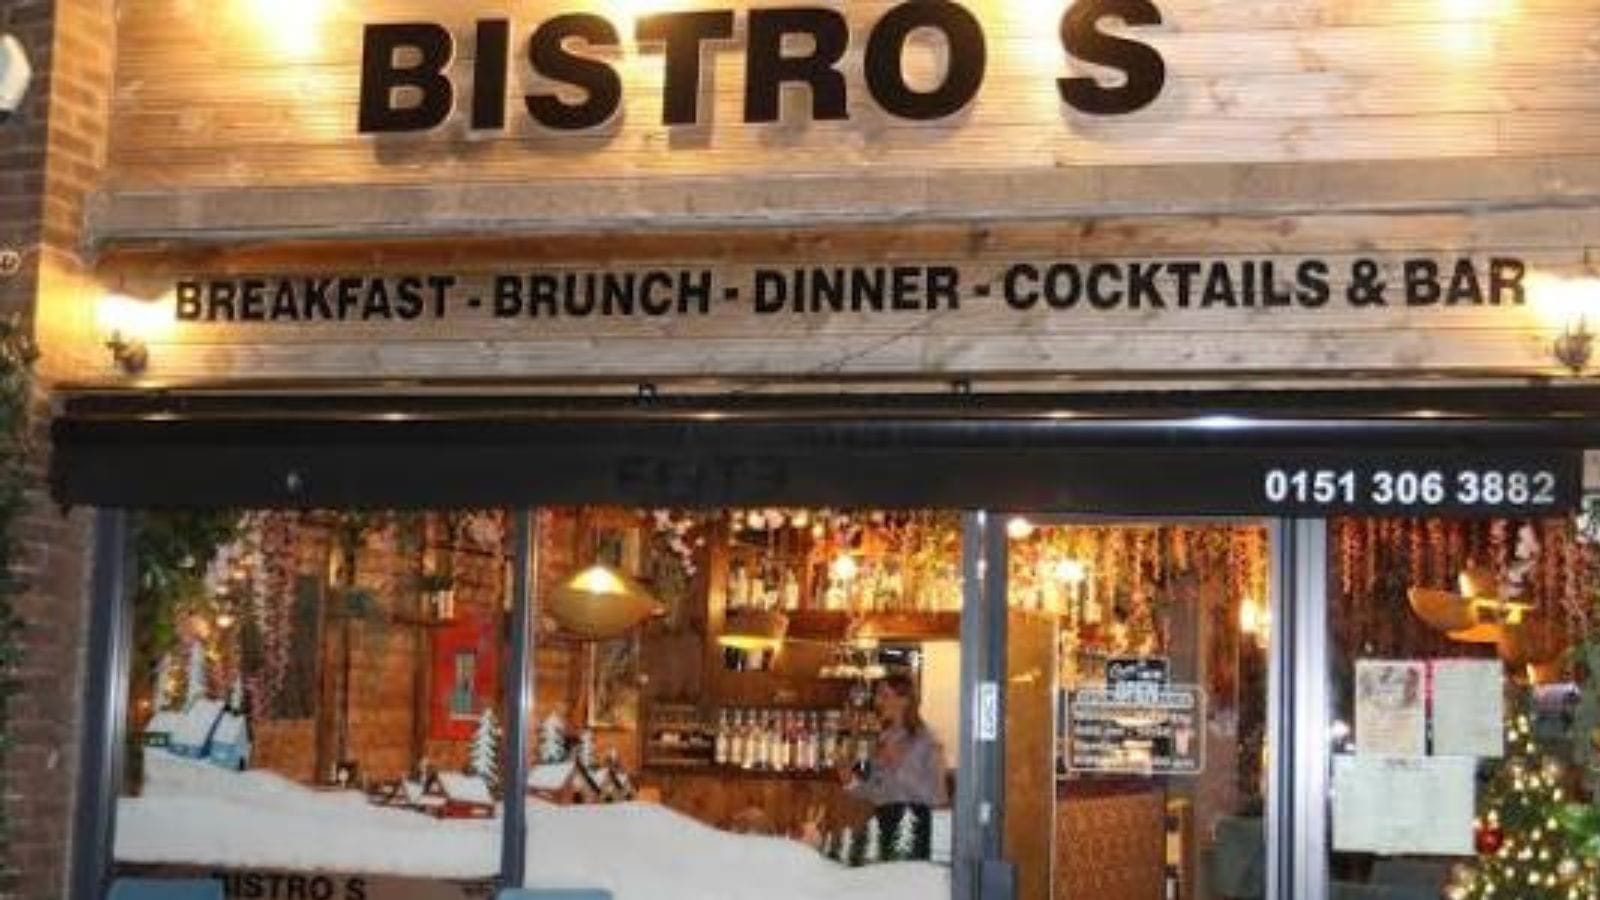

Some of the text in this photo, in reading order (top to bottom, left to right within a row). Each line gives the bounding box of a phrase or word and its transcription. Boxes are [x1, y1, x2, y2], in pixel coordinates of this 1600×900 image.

[359, 0, 1165, 133] BISTRO S
[176, 276, 454, 322] BREAKFAST
[494, 270, 712, 318] BRUNCH
[753, 266, 961, 314] DINNER
[1003, 261, 1330, 311] COCKTAILS
[1347, 260, 1386, 307] &
[1404, 258, 1526, 306] BAR
[1265, 469, 1556, 505] 0151 306 3882
